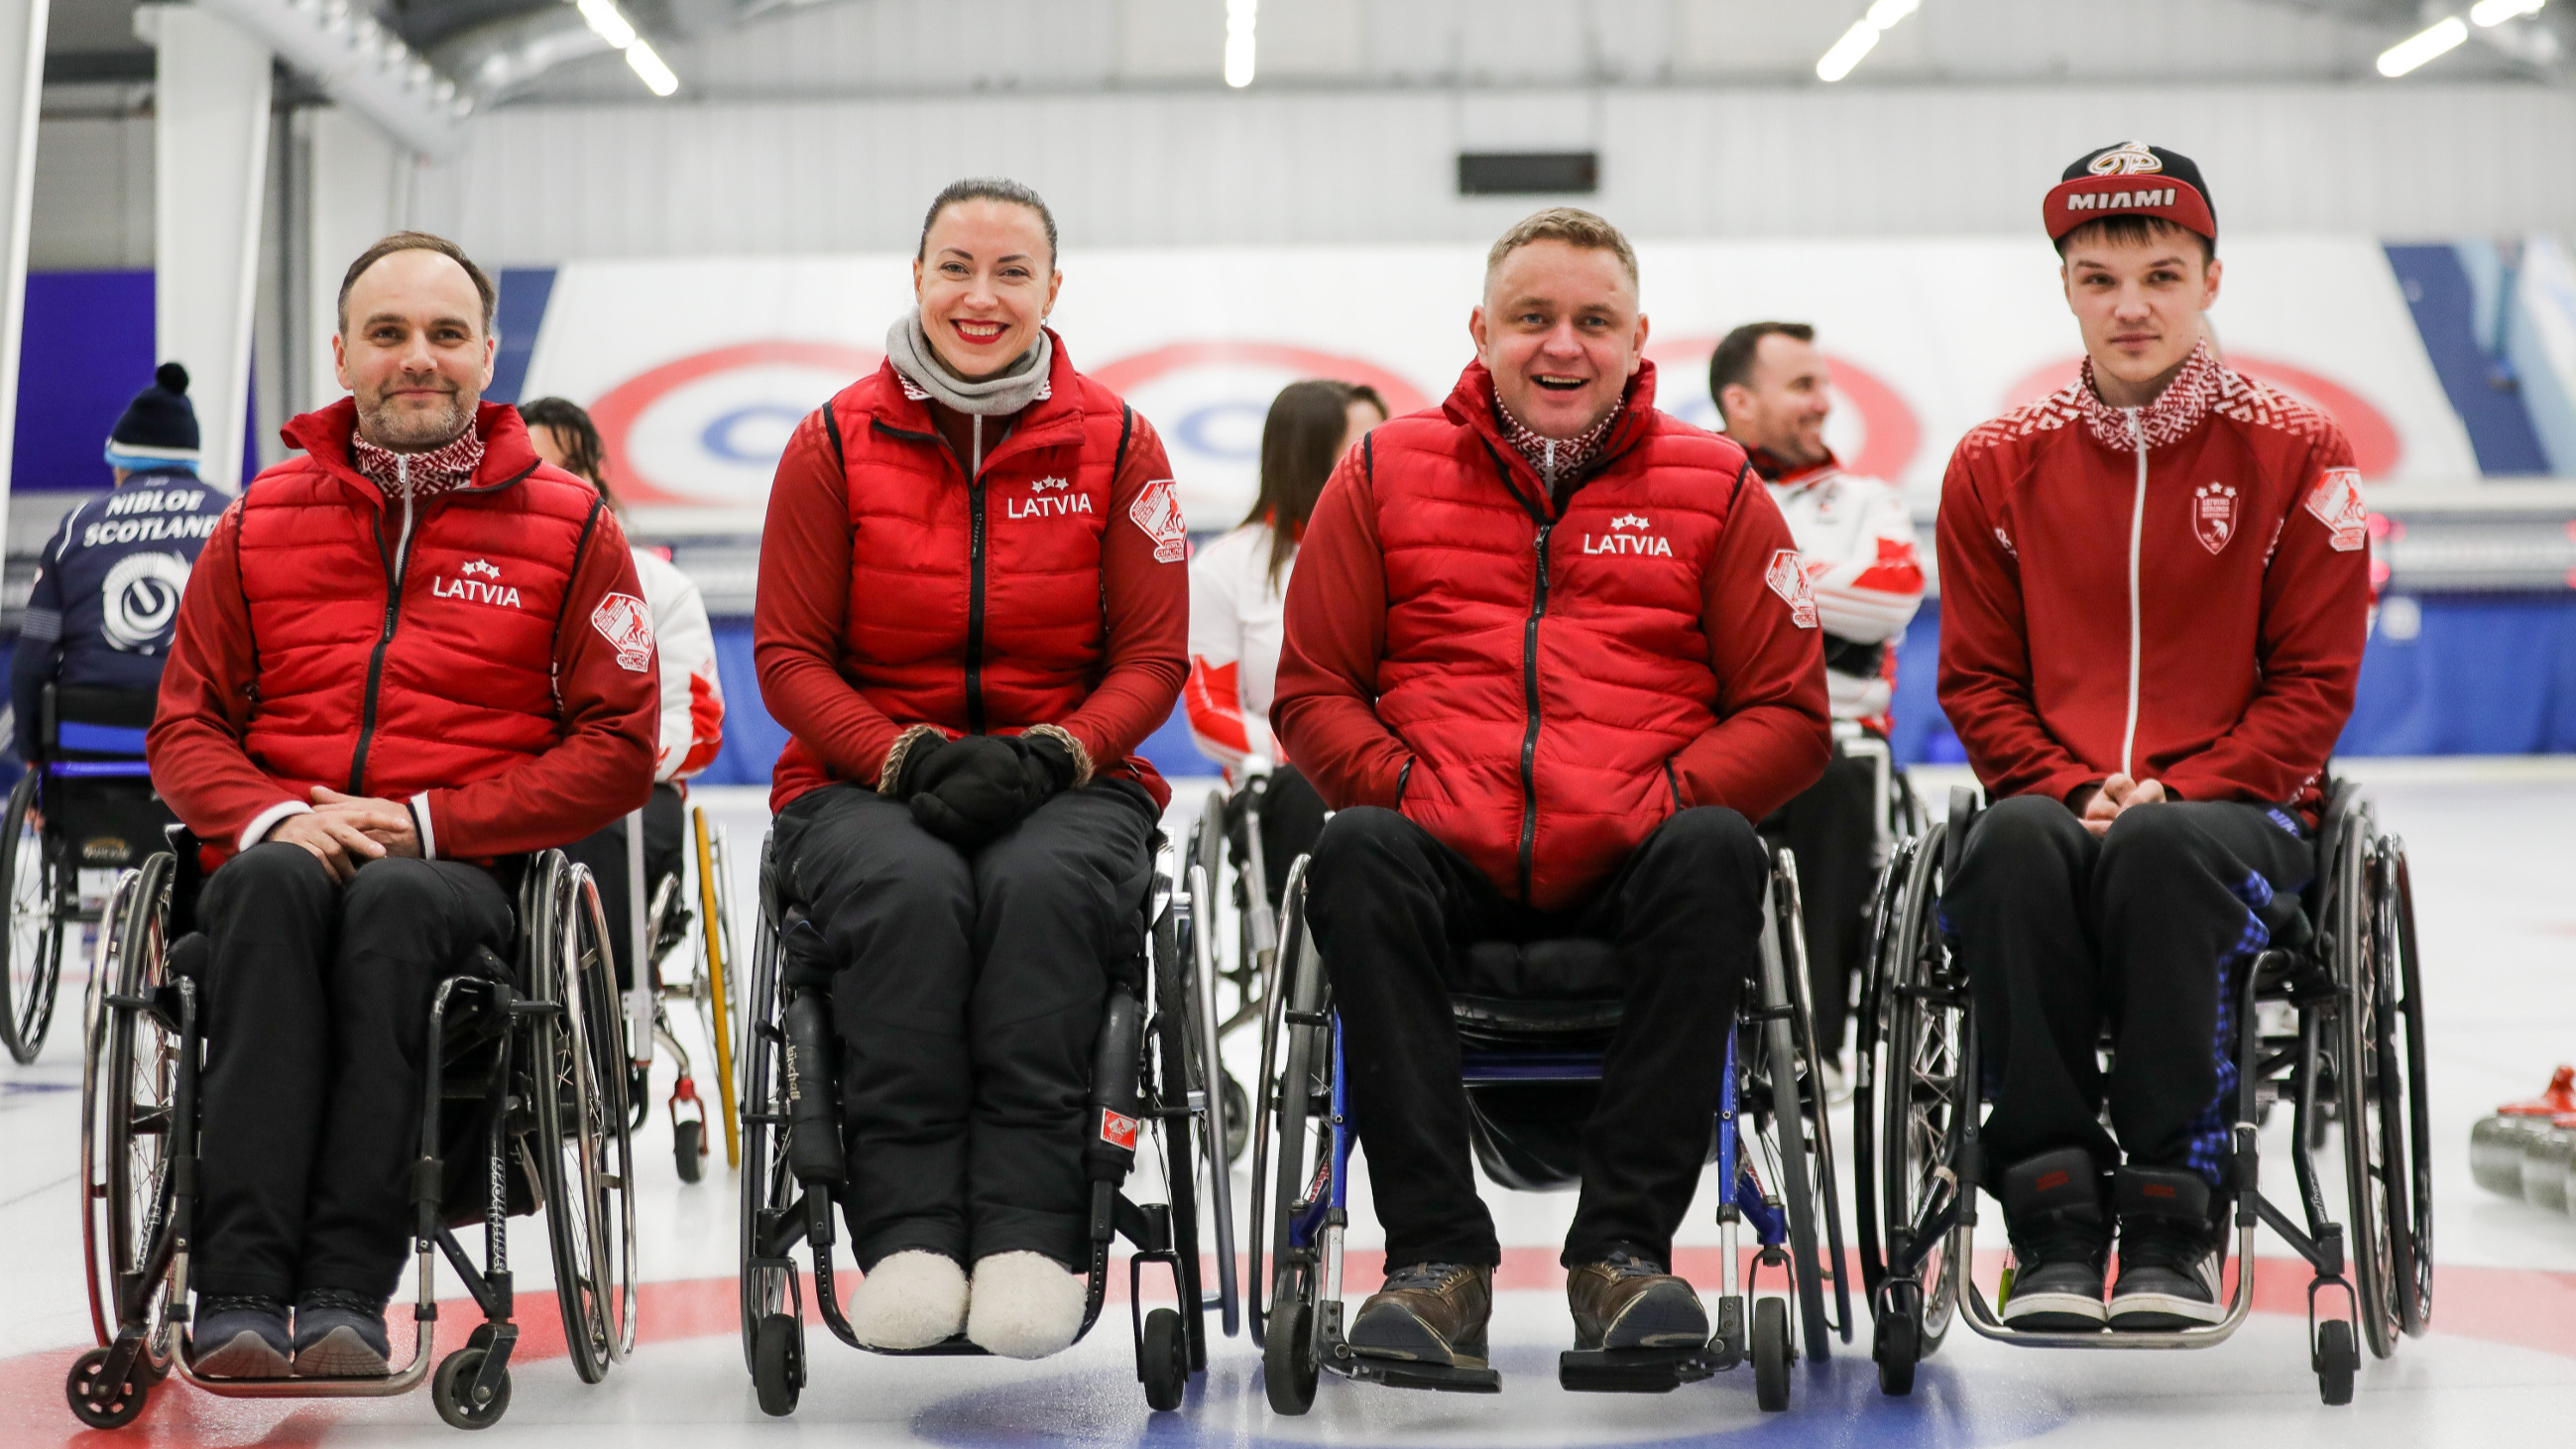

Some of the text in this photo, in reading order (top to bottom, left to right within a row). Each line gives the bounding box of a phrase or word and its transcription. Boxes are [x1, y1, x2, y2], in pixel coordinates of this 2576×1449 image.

[2067, 188, 2176, 210] MIAMI
[105, 490, 205, 518] NIBLOE
[1007, 493, 1093, 519] LATVIA
[1583, 534, 1673, 557] LATVIA
[433, 576, 521, 608] LATVIA
